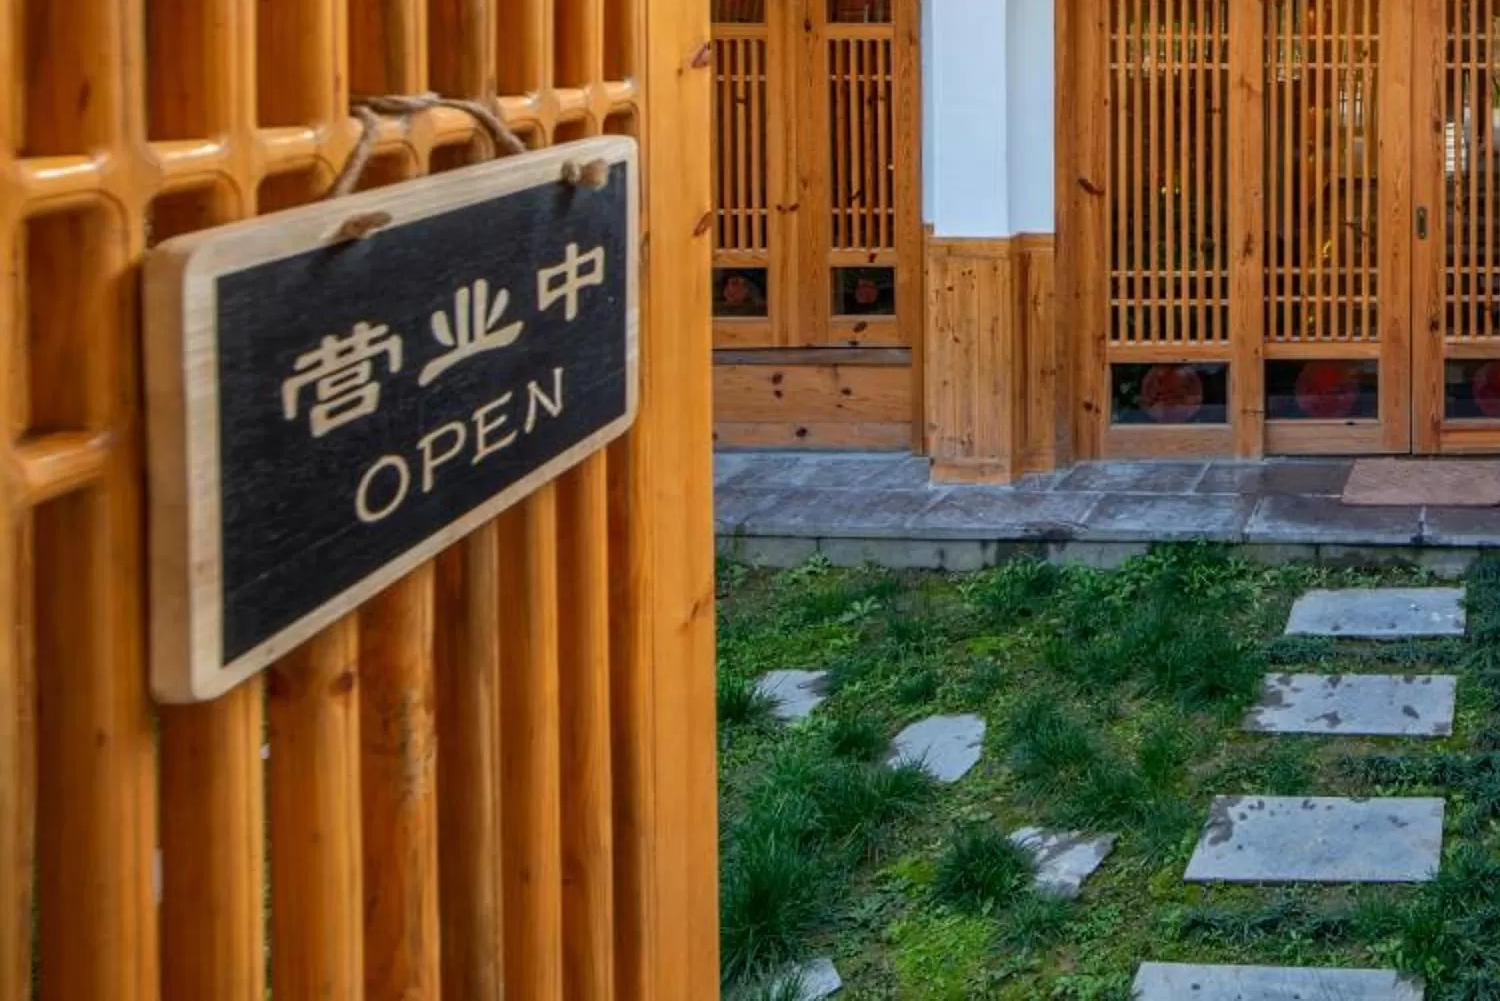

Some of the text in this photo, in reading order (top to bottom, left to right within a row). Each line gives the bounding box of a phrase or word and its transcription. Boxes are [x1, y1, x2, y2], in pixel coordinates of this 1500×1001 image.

[281, 241, 605, 438] 营业中
[354, 366, 565, 523] OPEN
